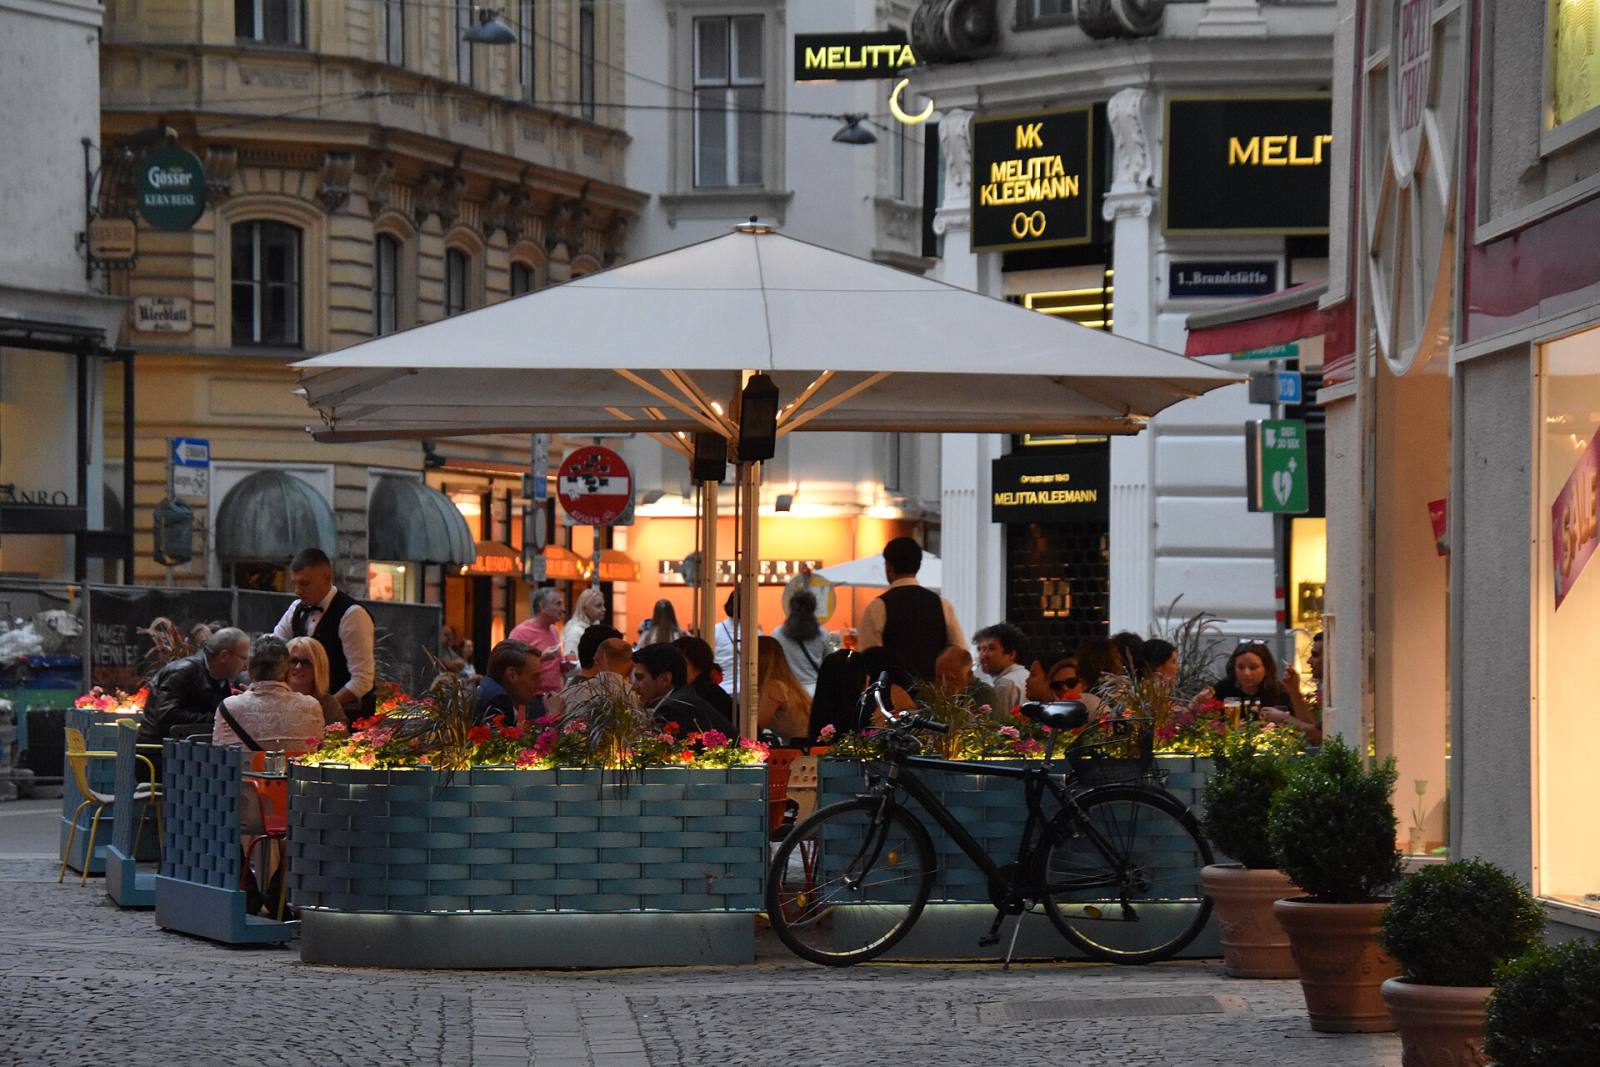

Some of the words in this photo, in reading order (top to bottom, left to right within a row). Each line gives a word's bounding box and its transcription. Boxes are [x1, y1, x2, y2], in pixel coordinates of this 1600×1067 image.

[804, 44, 916, 69] MELITTA
[1015, 122, 1044, 150] MK
[990, 154, 1065, 183] MELITTA
[980, 174, 1080, 206] KLEEMANN
[994, 491, 1038, 505] MELITTA
[1038, 489, 1097, 503] KLEEMANN
